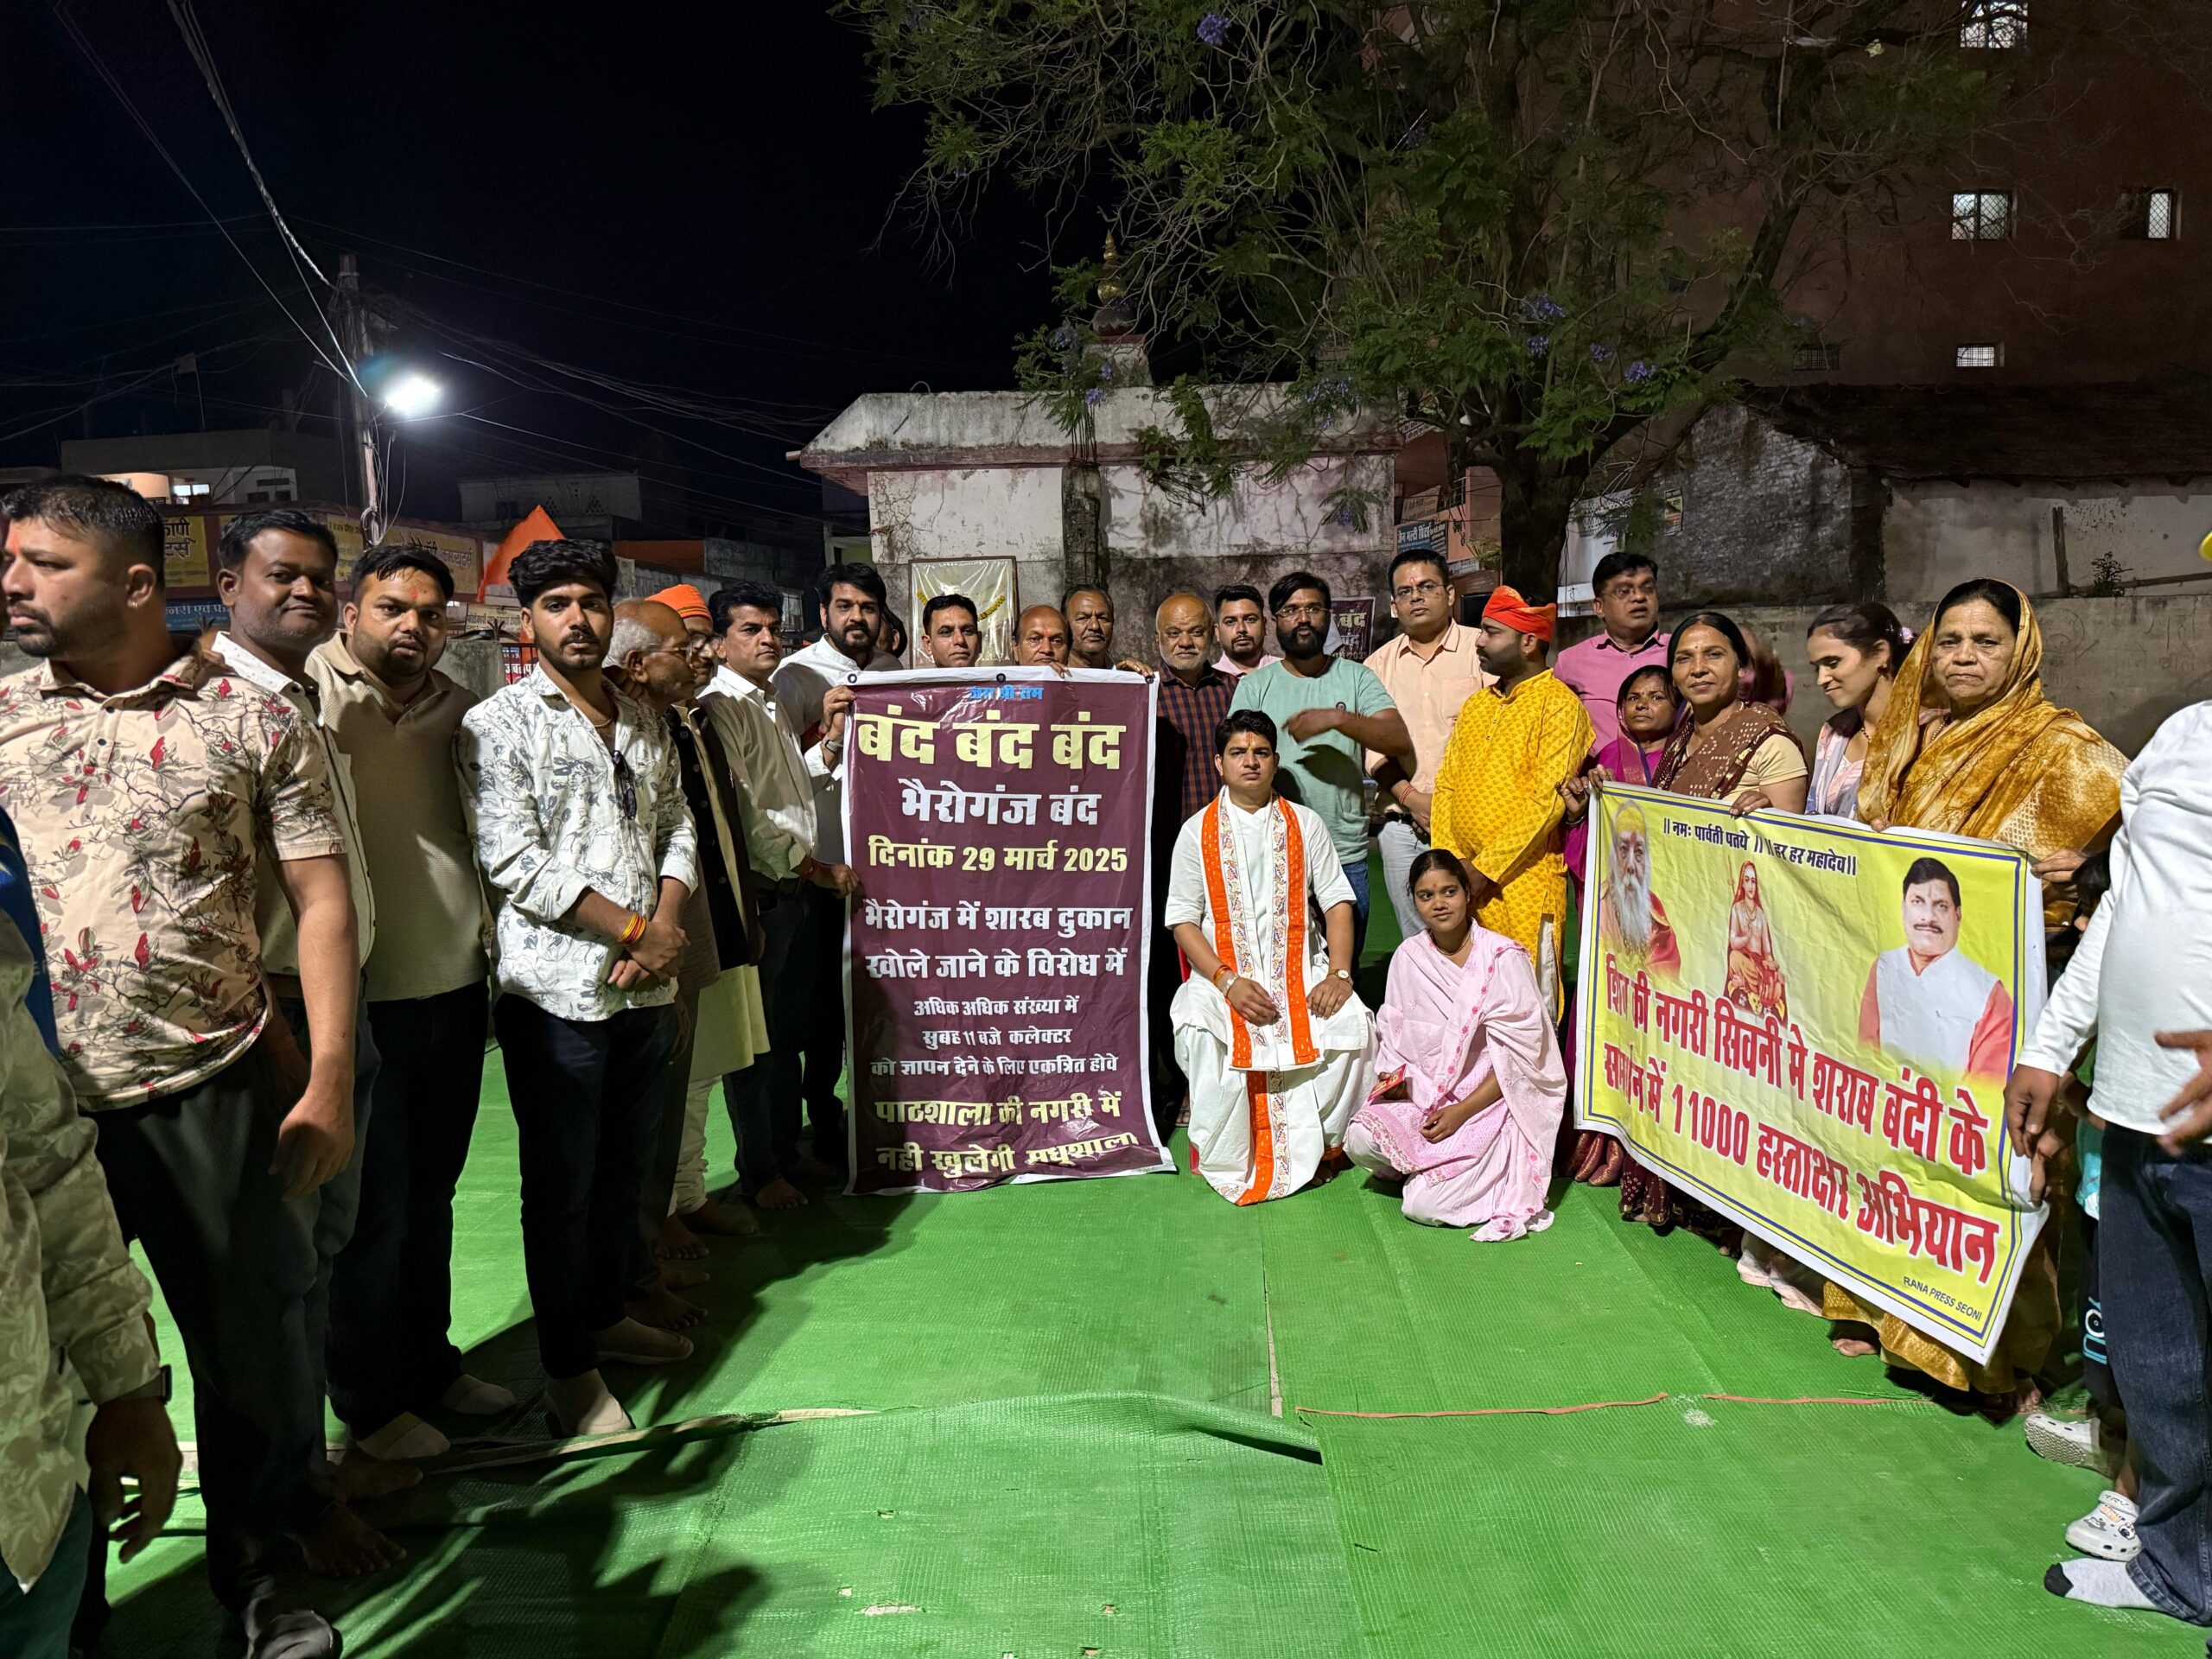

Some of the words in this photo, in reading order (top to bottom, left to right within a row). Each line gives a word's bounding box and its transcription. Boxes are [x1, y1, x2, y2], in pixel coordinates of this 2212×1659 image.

[1339, 608, 1367, 628] बंद
[1020, 687, 1044, 700] राम
[854, 704, 940, 765] बंद
[952, 709, 1039, 770] बंद
[1051, 711, 1127, 770] बंद
[898, 778, 1042, 826] भैरोगंज
[1049, 785, 1102, 826] बंद
[868, 835, 956, 868] दिनांक
[962, 846, 995, 871] 29
[1003, 840, 1058, 870] मार्च
[1063, 847, 1128, 872] 2025
[1694, 823, 1724, 845] पार्वती
[1789, 846, 1805, 864] हर
[863, 898, 951, 931] भैरोगंज
[957, 900, 981, 930] में
[984, 907, 1052, 931] शारब
[1057, 907, 1134, 938] दुकान
[865, 948, 930, 978] खोले
[935, 948, 988, 978] जाने
[994, 948, 1020, 978] के
[1027, 948, 1100, 977] विरोध
[1104, 948, 1128, 976] में
[913, 996, 959, 1016] अधिक
[962, 996, 1009, 1016] अधिक
[1013, 995, 1061, 1014] संख्या
[1065, 995, 1080, 1014] में
[922, 1029, 961, 1050] सुबह
[962, 1030, 976, 1046] 11
[978, 1027, 1001, 1046] बजे
[1008, 1026, 1072, 1045] कलेक्टर
[870, 1057, 896, 1076] को
[954, 1055, 979, 1077] देने
[982, 1056, 995, 1075] के
[996, 1058, 1026, 1075] लिए
[1028, 1054, 1086, 1075] एकत्रित
[1089, 1053, 1119, 1072] होवे
[1631, 970, 1651, 1034] की
[1655, 989, 1709, 1057] नगरी
[1714, 998, 1783, 1089] सिवनी
[1787, 1023, 1808, 1101] मे
[1813, 1052, 1878, 1135] शराब
[1883, 1067, 1943, 1163] बंदी
[1948, 1088, 1988, 1176] के
[874, 1100, 993, 1126] पाठशाला
[996, 1095, 1024, 1125] की
[1028, 1092, 1092, 1124] नगरी
[1098, 1090, 1122, 1117] में
[876, 1142, 924, 1172] नही
[929, 1143, 1015, 1179] खुलेगी
[1647, 1056, 1667, 1123] में
[1672, 1084, 1749, 1166] 11000
[1757, 1122, 1849, 1220] हस्ताक्षर
[1857, 1170, 1999, 1284] अभियान
[1904, 1275, 1929, 1294] RANA
[1930, 1287, 1955, 1306] PRESS
[1955, 1301, 1982, 1321] SEONI
